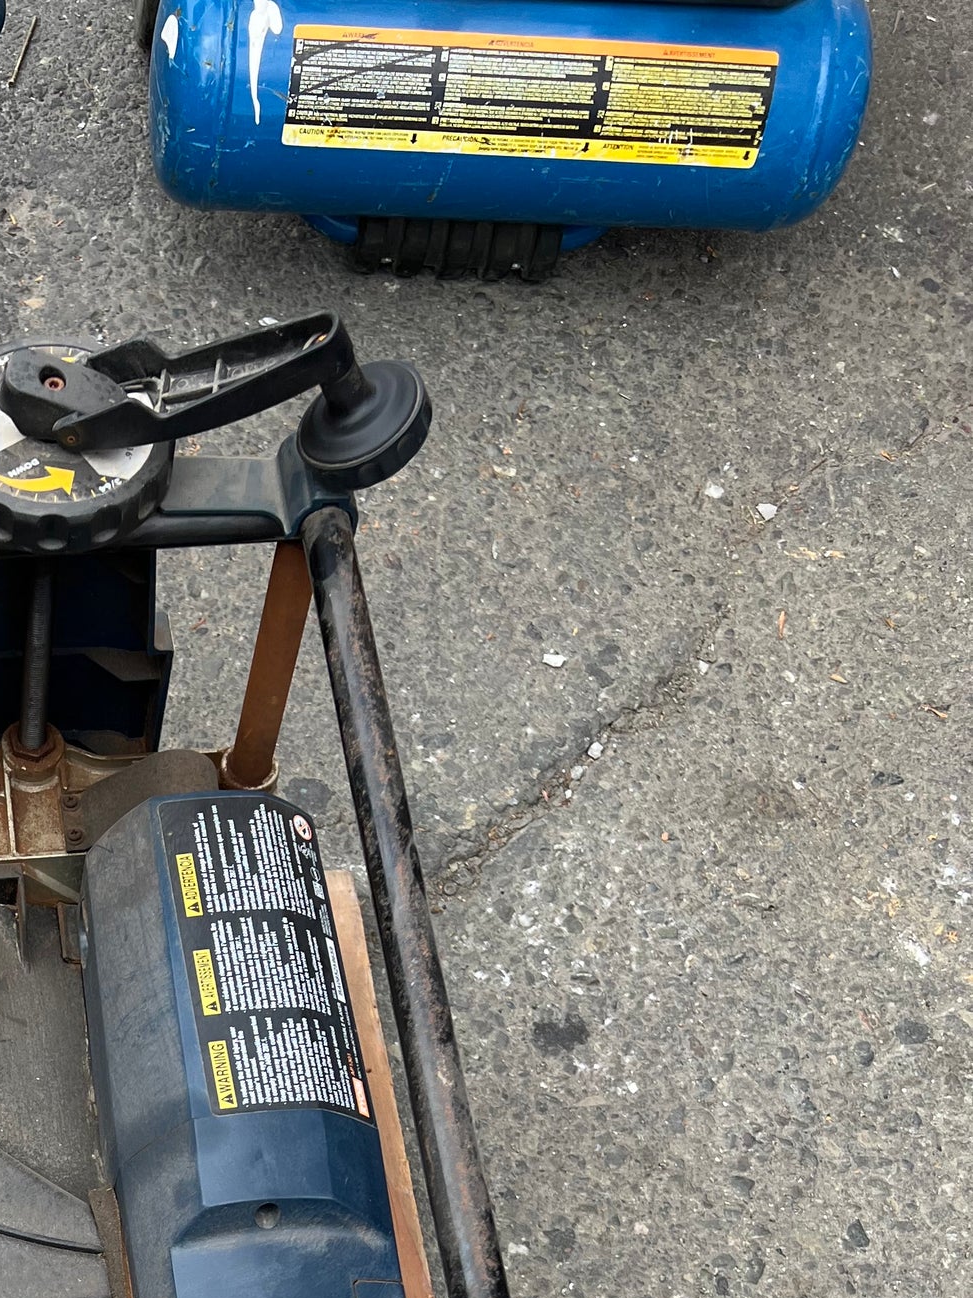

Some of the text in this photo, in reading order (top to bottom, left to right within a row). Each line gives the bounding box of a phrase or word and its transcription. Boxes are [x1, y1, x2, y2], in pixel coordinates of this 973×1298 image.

[7, 457, 40, 478] DOWN
[179, 855, 197, 900] ADVERTENCIA
[195, 951, 215, 999] AVERTISSEMENT
[211, 1043, 231, 1093] WARNING
